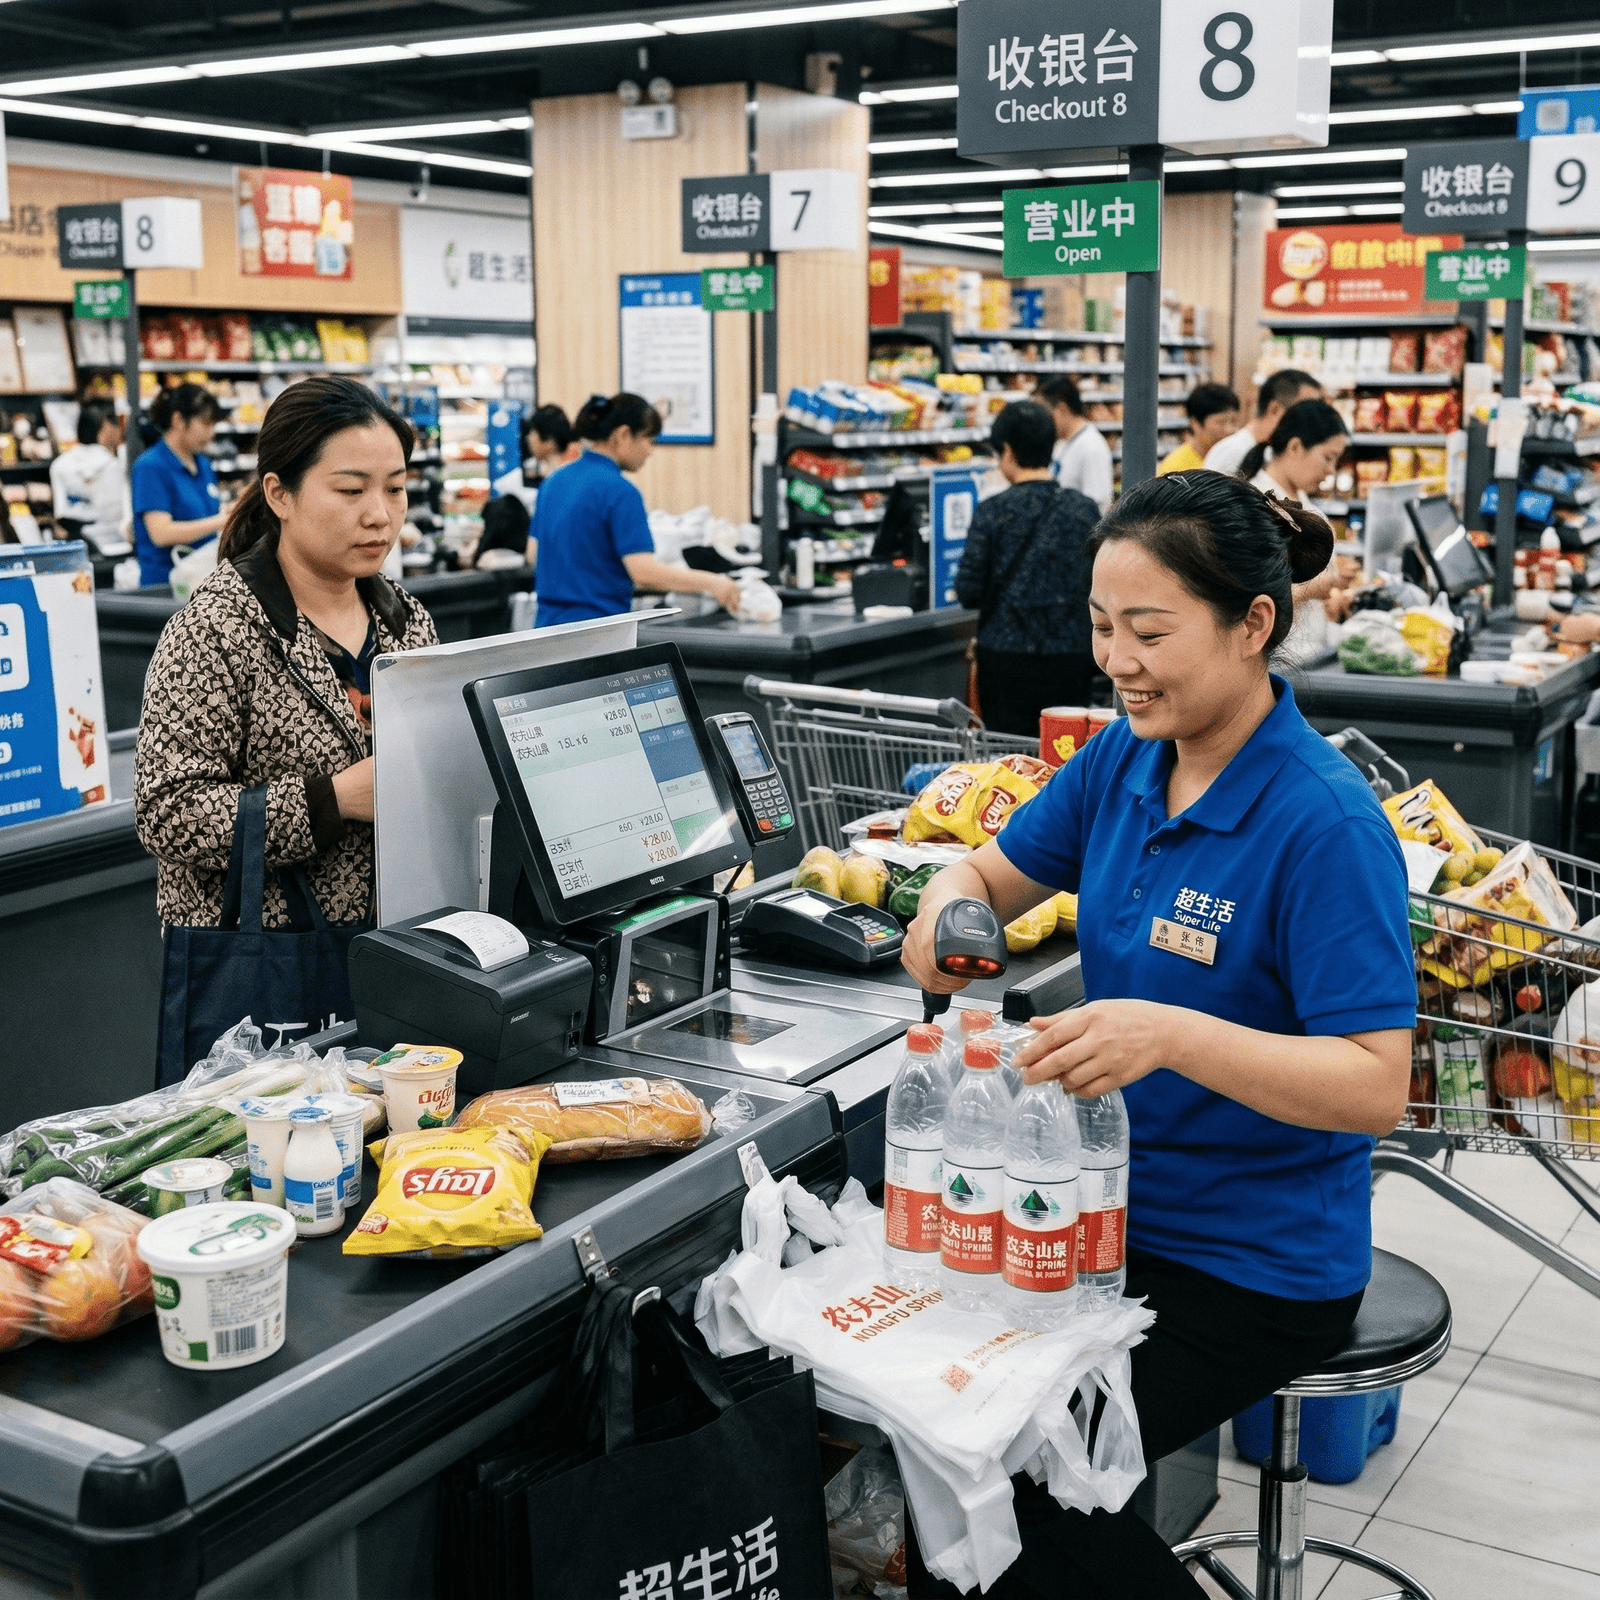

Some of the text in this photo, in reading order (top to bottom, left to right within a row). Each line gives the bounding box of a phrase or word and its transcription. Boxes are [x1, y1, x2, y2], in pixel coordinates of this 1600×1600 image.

[987, 28, 1138, 91] 收银台
[1199, 12, 1255, 102] 8
[995, 92, 1128, 124] Checkout 8
[1421, 161, 1515, 199] 收银台
[1555, 158, 1587, 206] 9
[692, 192, 763, 223] 收银台
[790, 190, 811, 231] 7
[1023, 196, 1135, 243] 营业中
[1424, 199, 1495, 217] Checkout
[137, 214, 154, 253] 8
[1055, 245, 1102, 266] Open
[1437, 254, 1511, 282] 营业中
[1173, 886, 1237, 924] 超生活
[1173, 909, 1202, 927] Super
[406, 1166, 495, 1198] Lay's
[1005, 1234, 1068, 1260] 农夫山泉
[821, 1284, 918, 1333] 农夫山
[851, 1290, 944, 1343] NONGFU SPRIN
